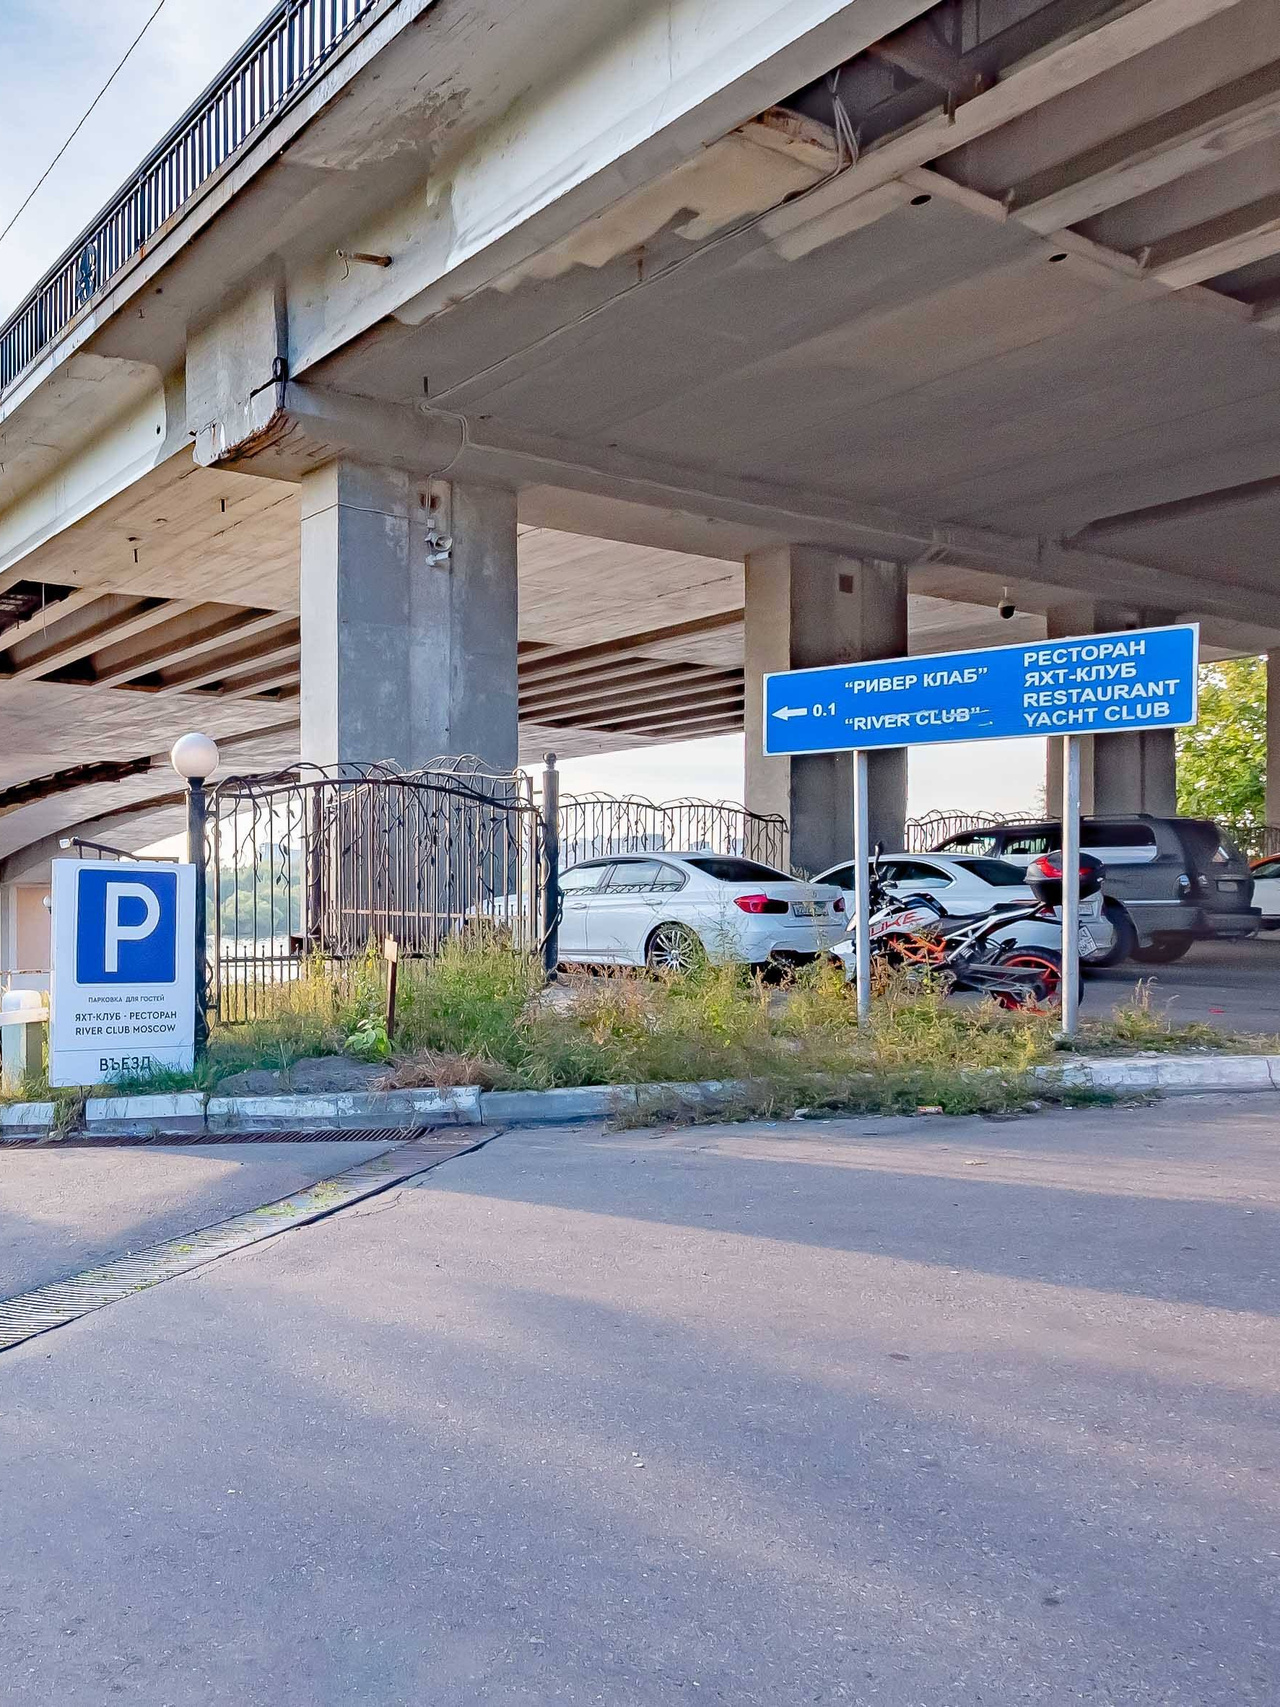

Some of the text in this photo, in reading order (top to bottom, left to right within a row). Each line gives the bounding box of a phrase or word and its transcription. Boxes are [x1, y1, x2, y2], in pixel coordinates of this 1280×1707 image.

[1023, 640, 1146, 667] РЕСТОРАН
[1023, 662, 1137, 687] ЯХТ-КЛУБ
[1023, 679, 1181, 708] RESTAURANT
[812, 702, 836, 717] 0.1
[1023, 701, 1170, 728] YACHT CLUB
[104, 881, 161, 973] P
[125, 995, 139, 1003] ДЛЯ
[140, 994, 165, 1002] ГОСТЕЙ
[75, 1012, 121, 1022] ЯХТ-КЛУБ
[129, 1011, 177, 1020] РЕСТОРАН
[75, 1024, 176, 1036] RIVER CLUB MOSCOW
[99, 1056, 151, 1072] ВЪЕЗД
